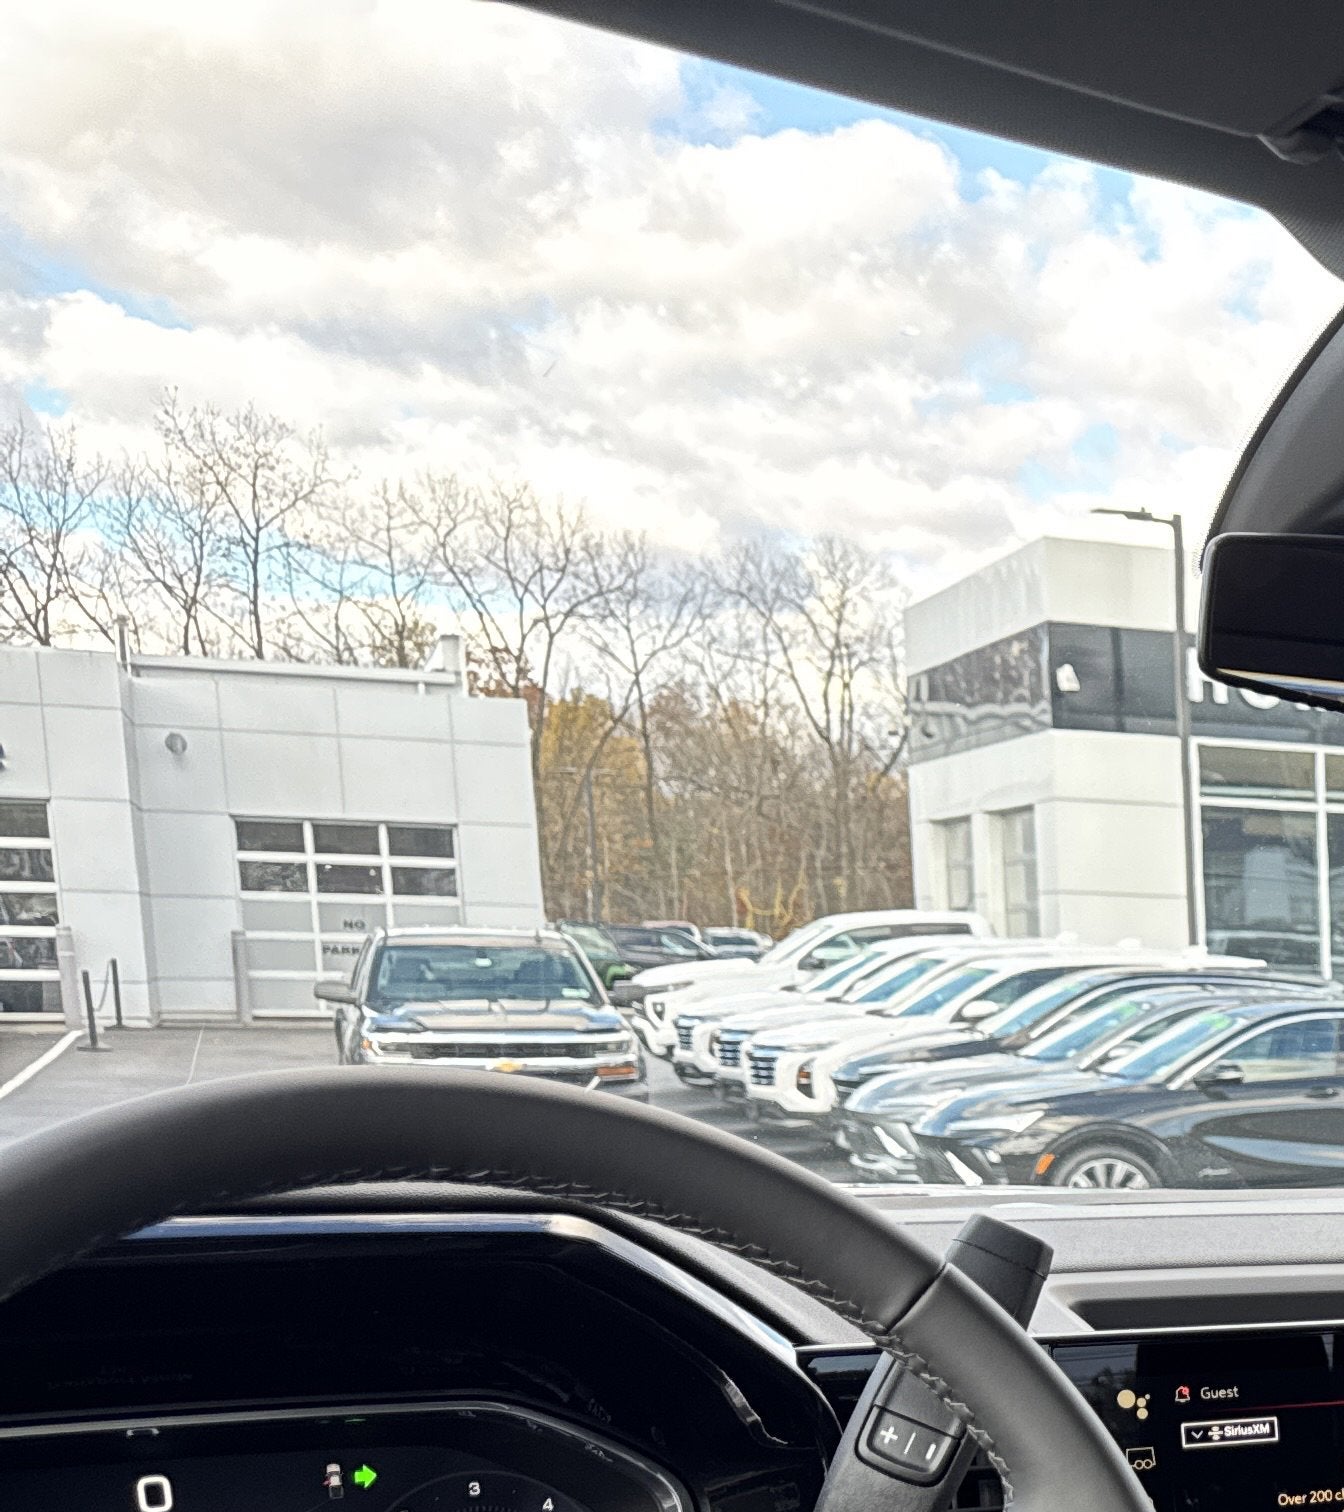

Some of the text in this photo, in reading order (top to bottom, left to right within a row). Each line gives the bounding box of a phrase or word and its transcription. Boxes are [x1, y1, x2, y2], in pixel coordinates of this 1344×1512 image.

[343, 919, 366, 929] NO
[1200, 1385, 1239, 1399] Guest
[1224, 1423, 1270, 1437] SiriusXM
[468, 1481, 481, 1497] 3
[542, 1497, 554, 1511] 4
[1278, 1492, 1307, 1505] Over
[1310, 1489, 1333, 1503] 200
